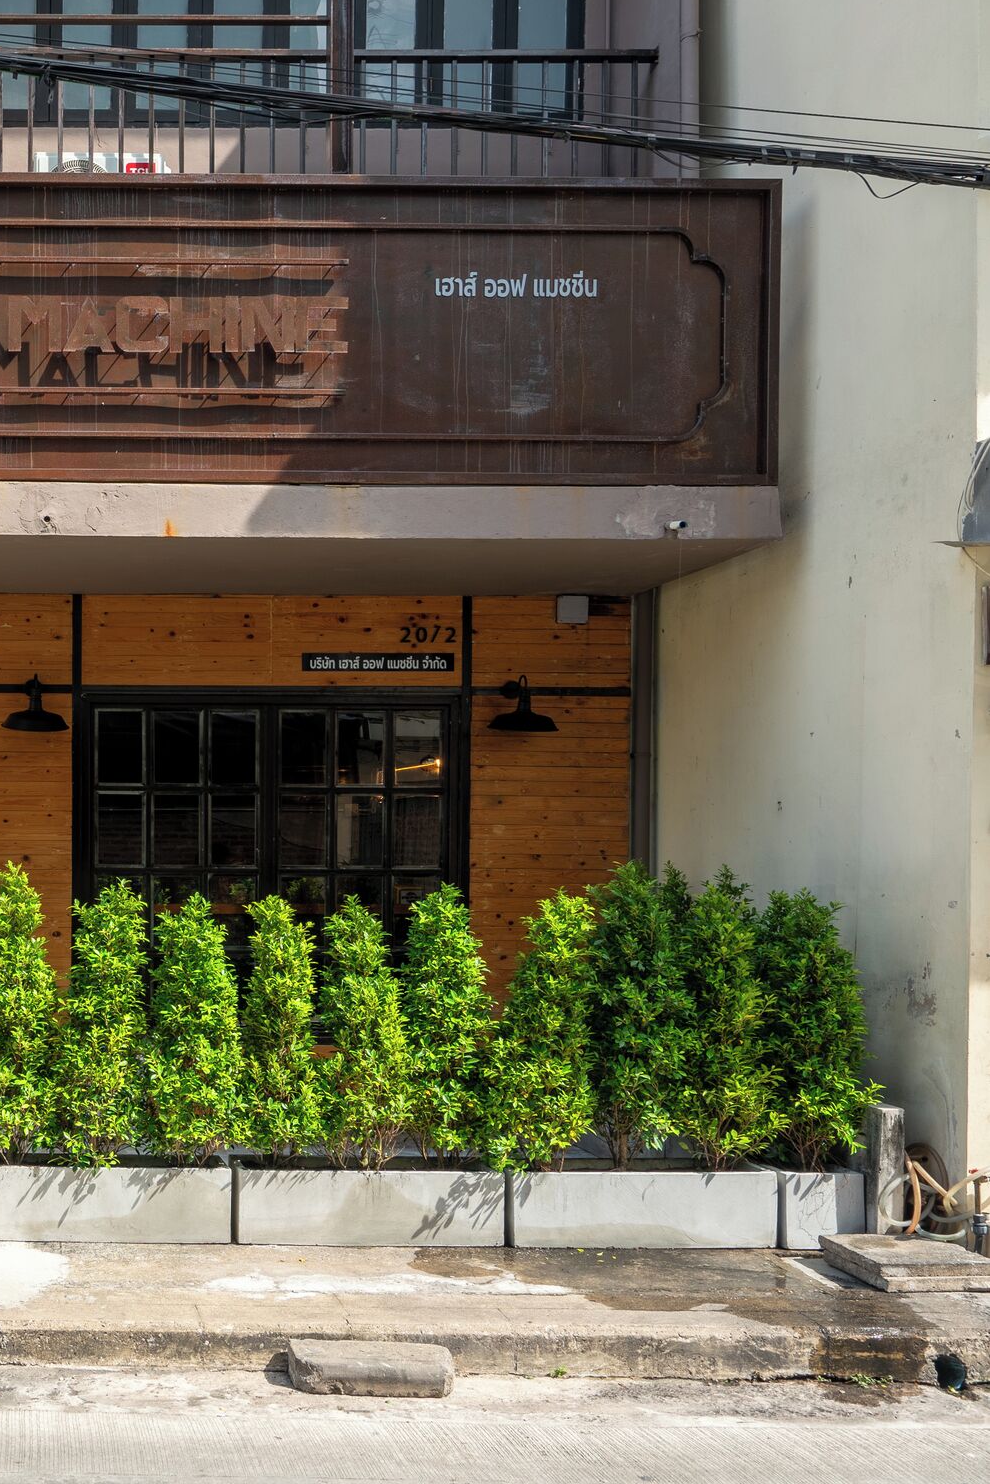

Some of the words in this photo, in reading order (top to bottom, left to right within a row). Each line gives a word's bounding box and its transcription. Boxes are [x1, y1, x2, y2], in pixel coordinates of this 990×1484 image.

[434, 271, 478, 298] เฮาส์
[483, 273, 527, 298] ออฟ
[533, 270, 598, 298] แมชชีน
[7, 294, 349, 354] MACHINE
[309, 656, 335, 670] บริษัท
[338, 656, 360, 670] เฮาส์
[363, 657, 384, 670] ออฟ
[387, 656, 419, 670] แมชชีน
[422, 655, 447, 670] จำกัด
